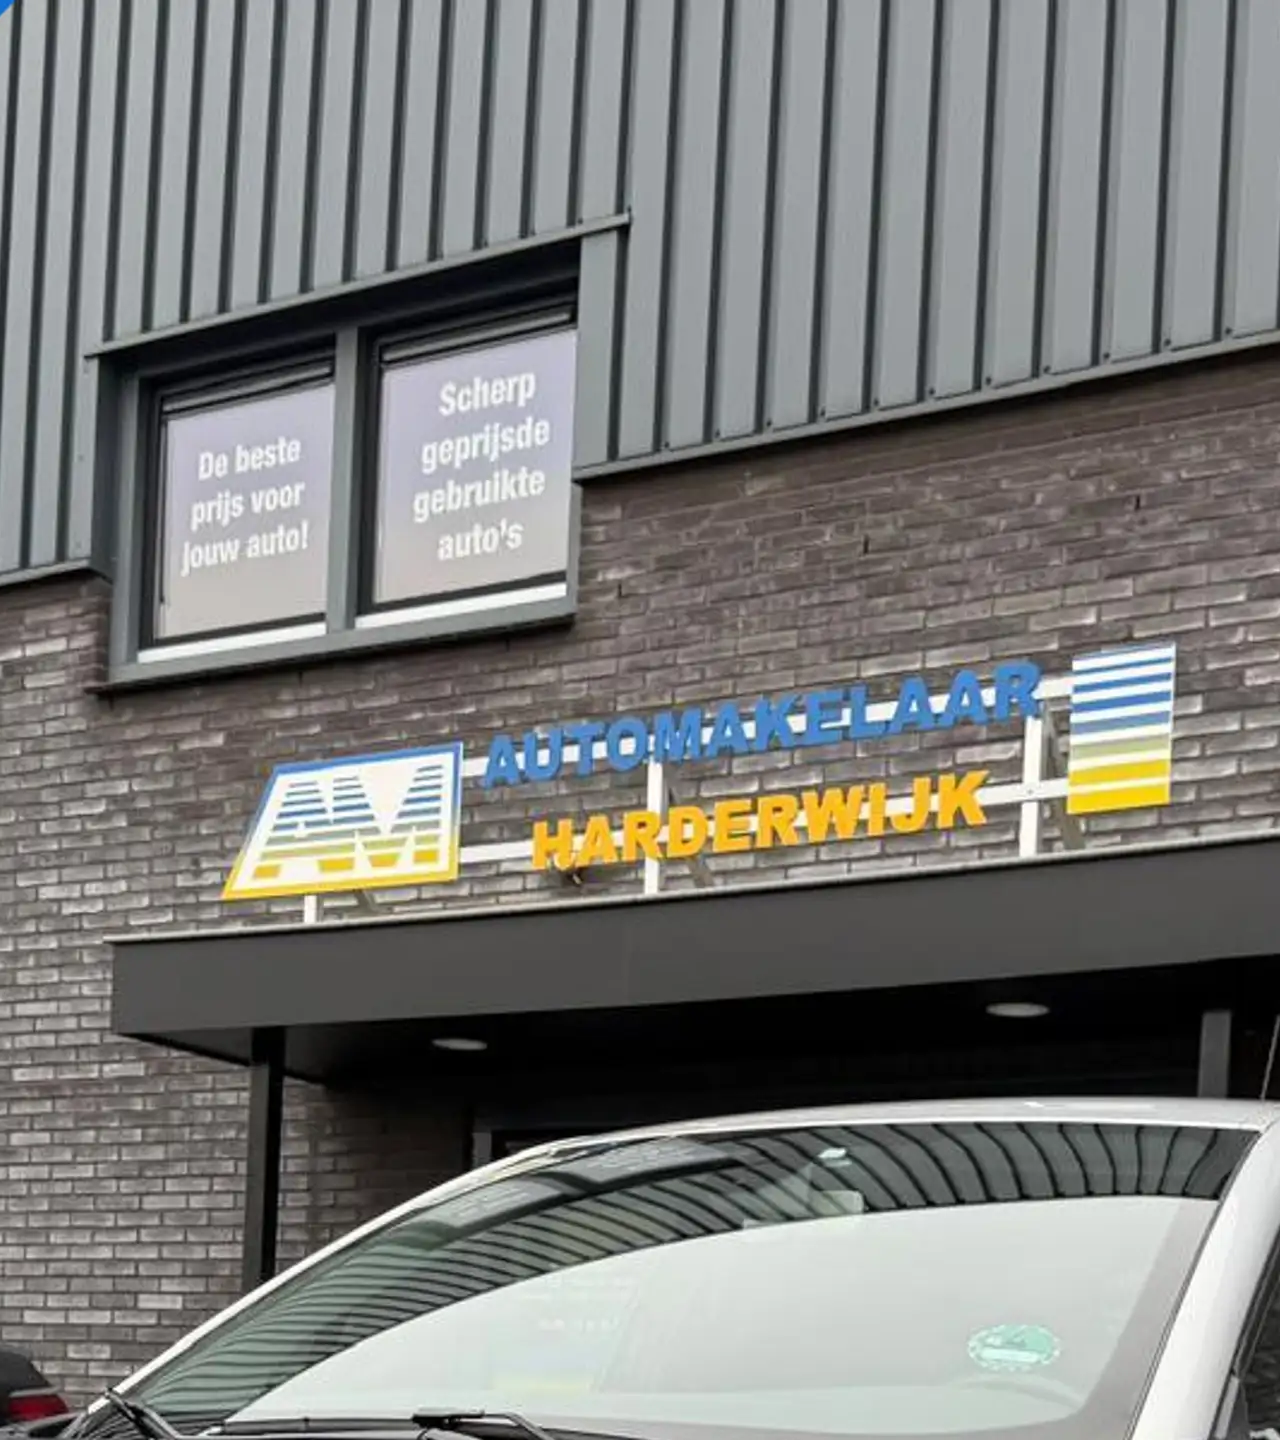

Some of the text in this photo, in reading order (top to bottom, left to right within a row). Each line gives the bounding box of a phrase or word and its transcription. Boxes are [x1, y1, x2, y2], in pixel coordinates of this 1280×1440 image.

[438, 372, 536, 417] Scherp
[199, 436, 302, 481] De beste
[421, 418, 550, 475] geprijsde
[191, 481, 305, 532] prijs voor
[412, 468, 546, 524] gebruikte
[246, 520, 309, 560] auto!
[438, 519, 524, 562] auto's
[483, 661, 1042, 789] AUTOMAKELAAR
[531, 771, 989, 871] HARDERWIJK
